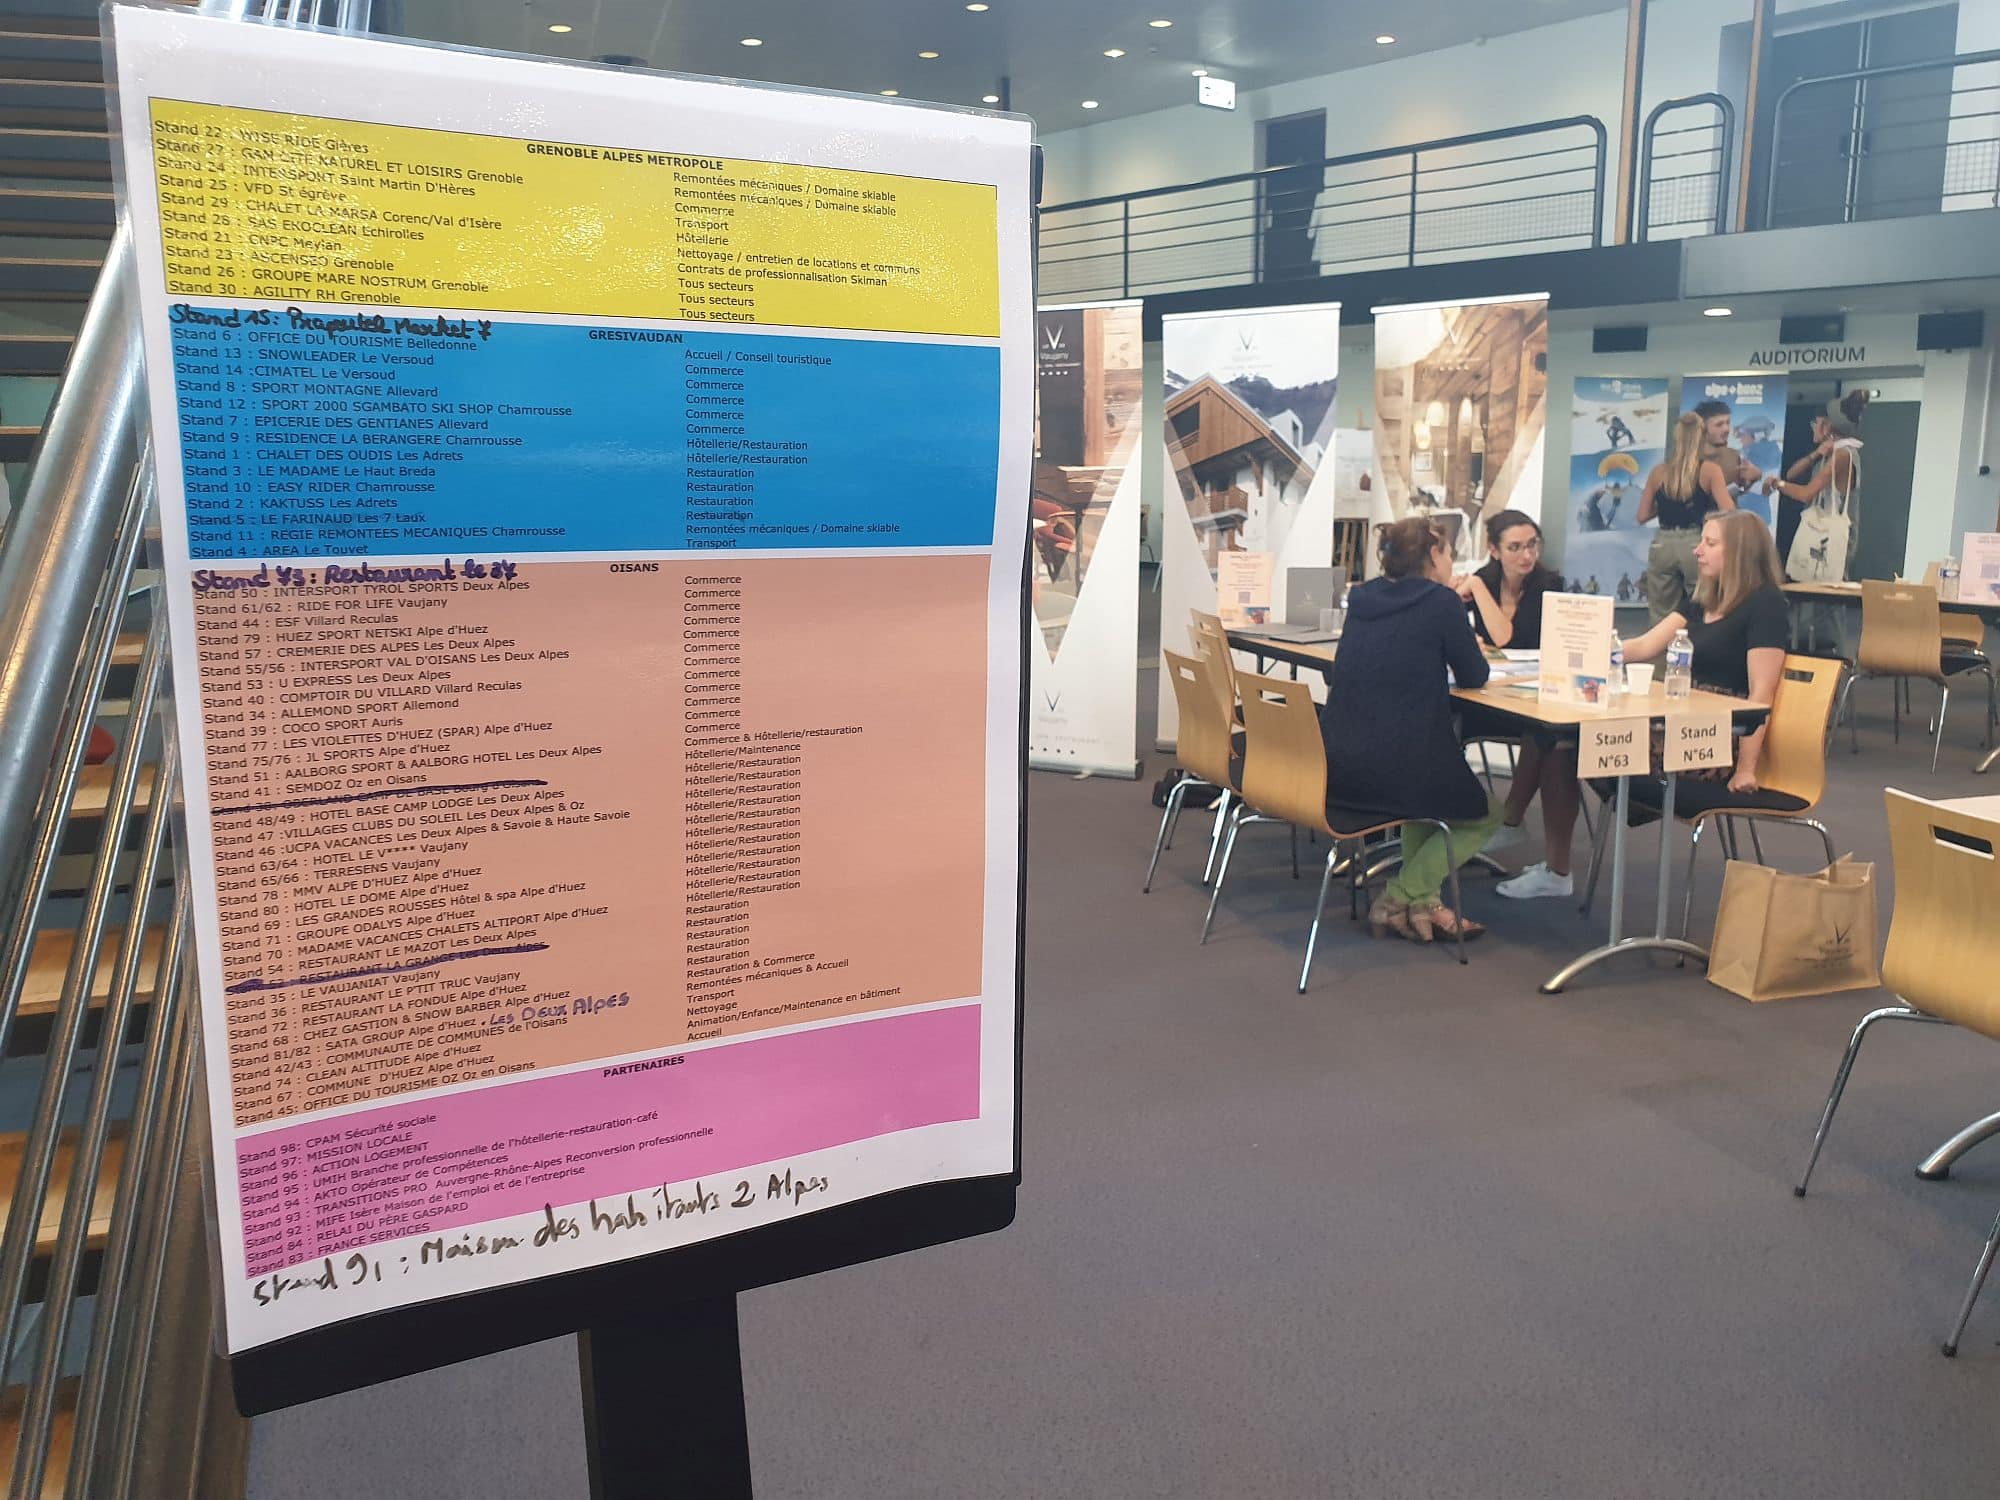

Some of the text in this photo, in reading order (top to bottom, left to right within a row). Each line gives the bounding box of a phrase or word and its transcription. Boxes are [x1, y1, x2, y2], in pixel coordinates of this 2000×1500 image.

[527, 144, 723, 170] GRENOBLE ALPES METROPOLE
[674, 172, 735, 186] Remontées
[815, 185, 858, 197] Domaine
[863, 191, 895, 201] skiable
[164, 263, 488, 292] Stand 26 GROUPE MARE NOSTRUM Grenoble
[678, 263, 888, 286] Contrats de professionnalisation Skiman
[679, 278, 753, 291] Tous secteurs
[166, 281, 400, 303] Stand 30 AGILITY RH Grenoble
[169, 304, 241, 328] Stand
[589, 330, 682, 343] GRESIVAUDAN
[176, 345, 433, 365] Stand 13 SNOWLEADER Le Versoud
[686, 350, 831, 366] Accueil Conseil touristique
[1749, 346, 1866, 367] AUDITORIUM
[686, 365, 744, 375] Commerce
[180, 397, 571, 415] Stand 12 SPORT 2000 SGAMBATO SKI SHOP Chamrousse
[183, 432, 522, 445] Stand 9 RESIDENCE LA BERANGERE Chamrousse
[687, 453, 807, 464] Hôtellerie/Restauration
[186, 466, 435, 478] Stand 3 LE MADAME Le Haut Breda
[186, 480, 435, 494] Stand 10 EASY RIDER Chamrousse
[687, 483, 753, 491] Restauration
[687, 523, 899, 535] Remontées mécaniques Domaine skiable
[686, 537, 736, 549] Transport
[192, 563, 270, 591] Stand
[325, 558, 456, 584] Restaurant
[610, 563, 658, 572] OISANS
[685, 576, 741, 584] Commerce
[199, 625, 488, 645] Stand 79 HUEZ SPORT NETSKI Alpe d'Huez
[201, 650, 569, 676] Stand 55/56 INTERSPORT VAL D'OISANS Les Deux Alpes
[204, 681, 521, 708] Stand 40 COMPTOIR DU VILLARD Villard Reculas
[685, 736, 740, 746] Commerce
[755, 726, 862, 740] Hôtellerie/restauration
[1595, 731, 1633, 746] Stand
[1680, 724, 1717, 741] Stand
[686, 744, 800, 759] Hôtellerie/Maintenance
[1598, 754, 1630, 769] N°63
[1683, 746, 1715, 763] N°64
[223, 910, 474, 951] Stand 71 GROUPE ODALYS Alpe d'Huez
[229, 972, 520, 1025] Stand 36 RESTAURANT LE P'TIT TRUC Vaujany
[688, 997, 842, 1027] Animation/Enfance/Maintenance
[861, 988, 900, 999] bâtiment
[688, 1030, 721, 1040] Accueil
[604, 1056, 684, 1077] PARTENAIRES
[235, 1056, 494, 1111] Stand 67 COMMUNE D'HUEZ Alpe d'Huez
[239, 1115, 436, 1164] Stand 98: CPAM Sécurité sociale
[242, 1142, 427, 1192] Stand 96 ACTION LOGEMENT
[533, 1202, 581, 1248] des
[730, 1180, 756, 1208] 2
[767, 1167, 828, 1207] Alpes
